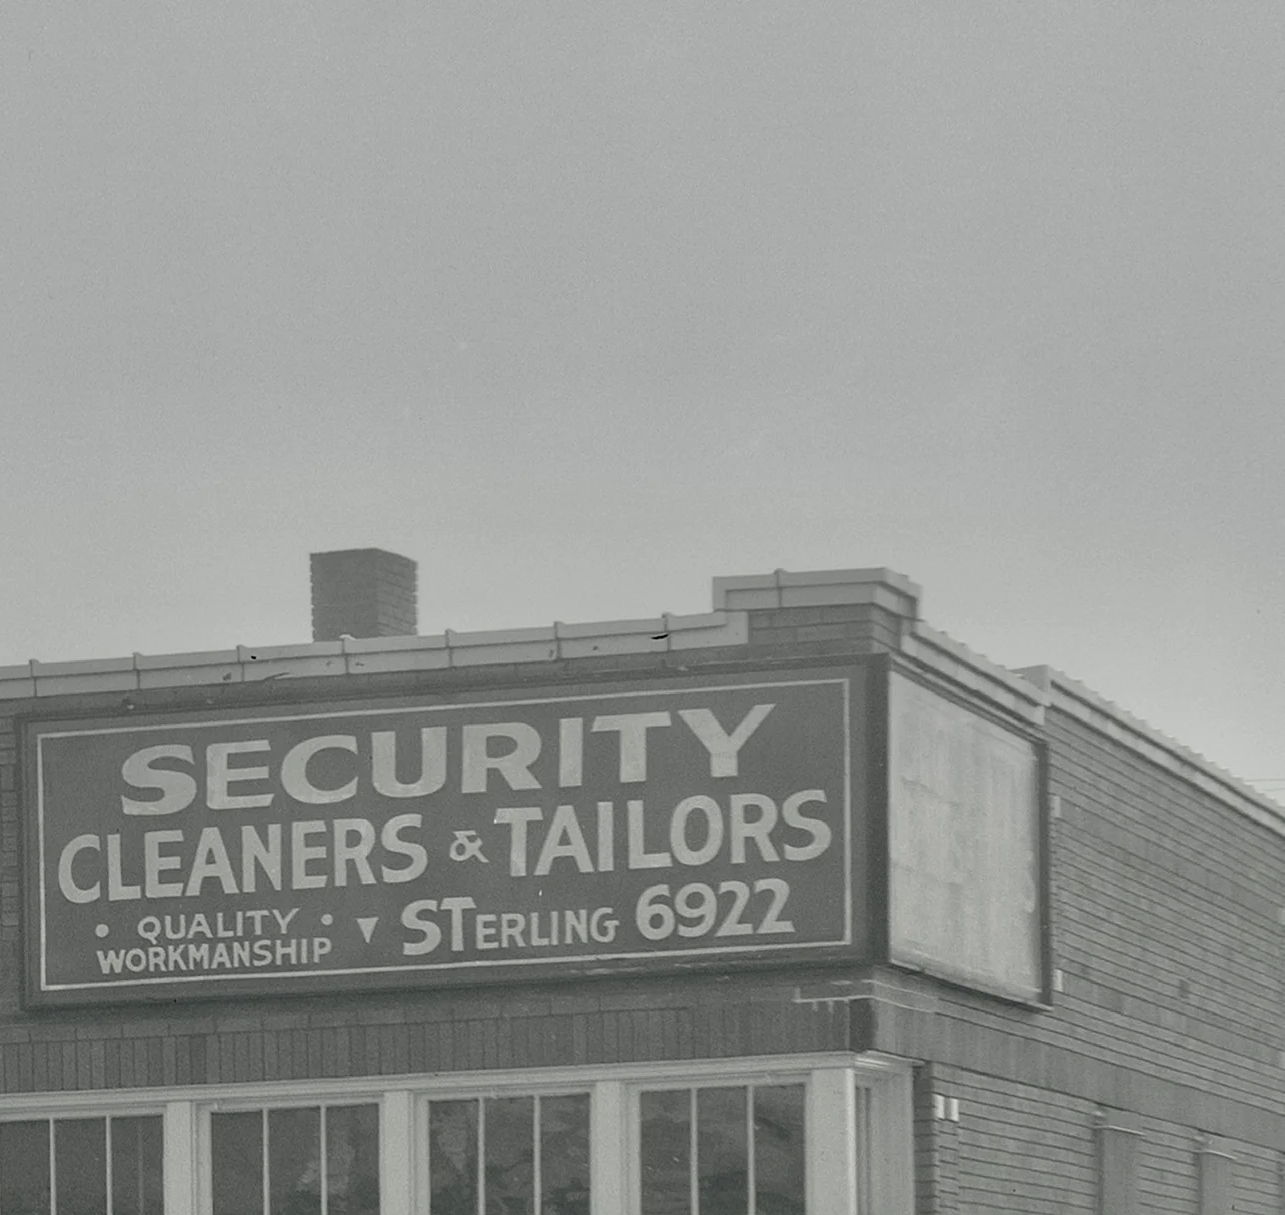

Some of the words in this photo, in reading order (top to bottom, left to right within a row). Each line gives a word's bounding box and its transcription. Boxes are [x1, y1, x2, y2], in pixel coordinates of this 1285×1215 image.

[120, 702, 777, 816] SECURITY
[57, 812, 429, 905] CLEANERS
[448, 829, 490, 865] &
[493, 788, 832, 877] TAILORS
[136, 907, 301, 944] QUALITY
[635, 877, 795, 940] 6922
[95, 936, 333, 974] WORKMANSHIP
